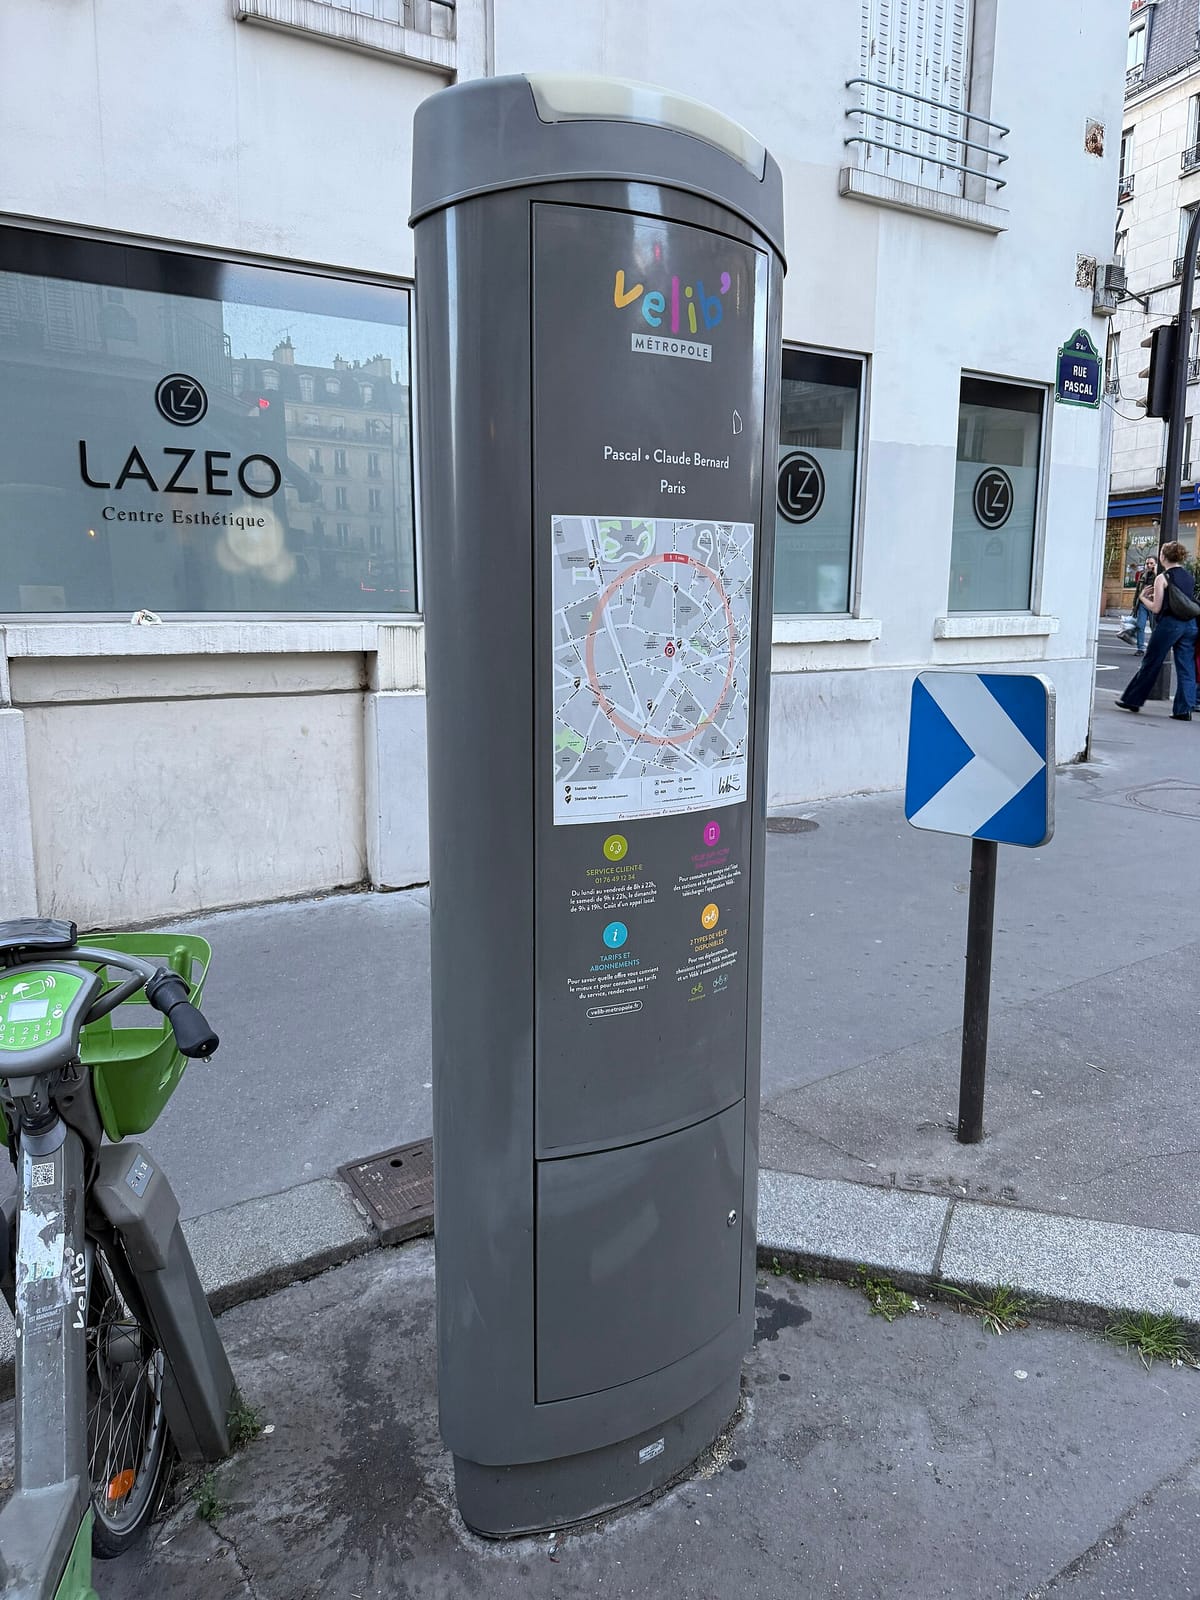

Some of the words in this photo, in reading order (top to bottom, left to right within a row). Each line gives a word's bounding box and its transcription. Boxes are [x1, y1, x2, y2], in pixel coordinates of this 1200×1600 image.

[635, 336, 708, 358] MÉTROPOLE
[1073, 365, 1088, 378] RUE
[1064, 380, 1093, 396] PASCAL
[604, 445, 641, 461] Pascal
[653, 449, 691, 465] Claude
[694, 452, 730, 469] Bernard
[79, 440, 282, 499] LAZEO
[660, 480, 686, 494] Paris
[102, 506, 164, 523] Centre
[171, 509, 266, 531] Esthétique
[586, 867, 615, 876] SERVICE
[604, 885, 626, 894] vendredi
[634, 889, 657, 898] dimanche
[629, 899, 642, 908] appel
[694, 935, 708, 944] TYPES
[695, 938, 724, 952] DISPONIBLES
[600, 954, 622, 962] TARIFS
[590, 959, 640, 972] ABONNEMENTS
[598, 974, 613, 982] quelle
[614, 971, 626, 979] offre
[639, 966, 659, 974] convient
[613, 979, 636, 987] connaître
[645, 973, 657, 982] tarifs
[608, 986, 637, 995] rendez-vous
[590, 1003, 639, 1016] velib-metropole.fr
[23, 1026, 29, 1035] 2
[46, 1019, 51, 1027] 4
[9, 1036, 15, 1044] 6
[21, 1036, 27, 1044] 7
